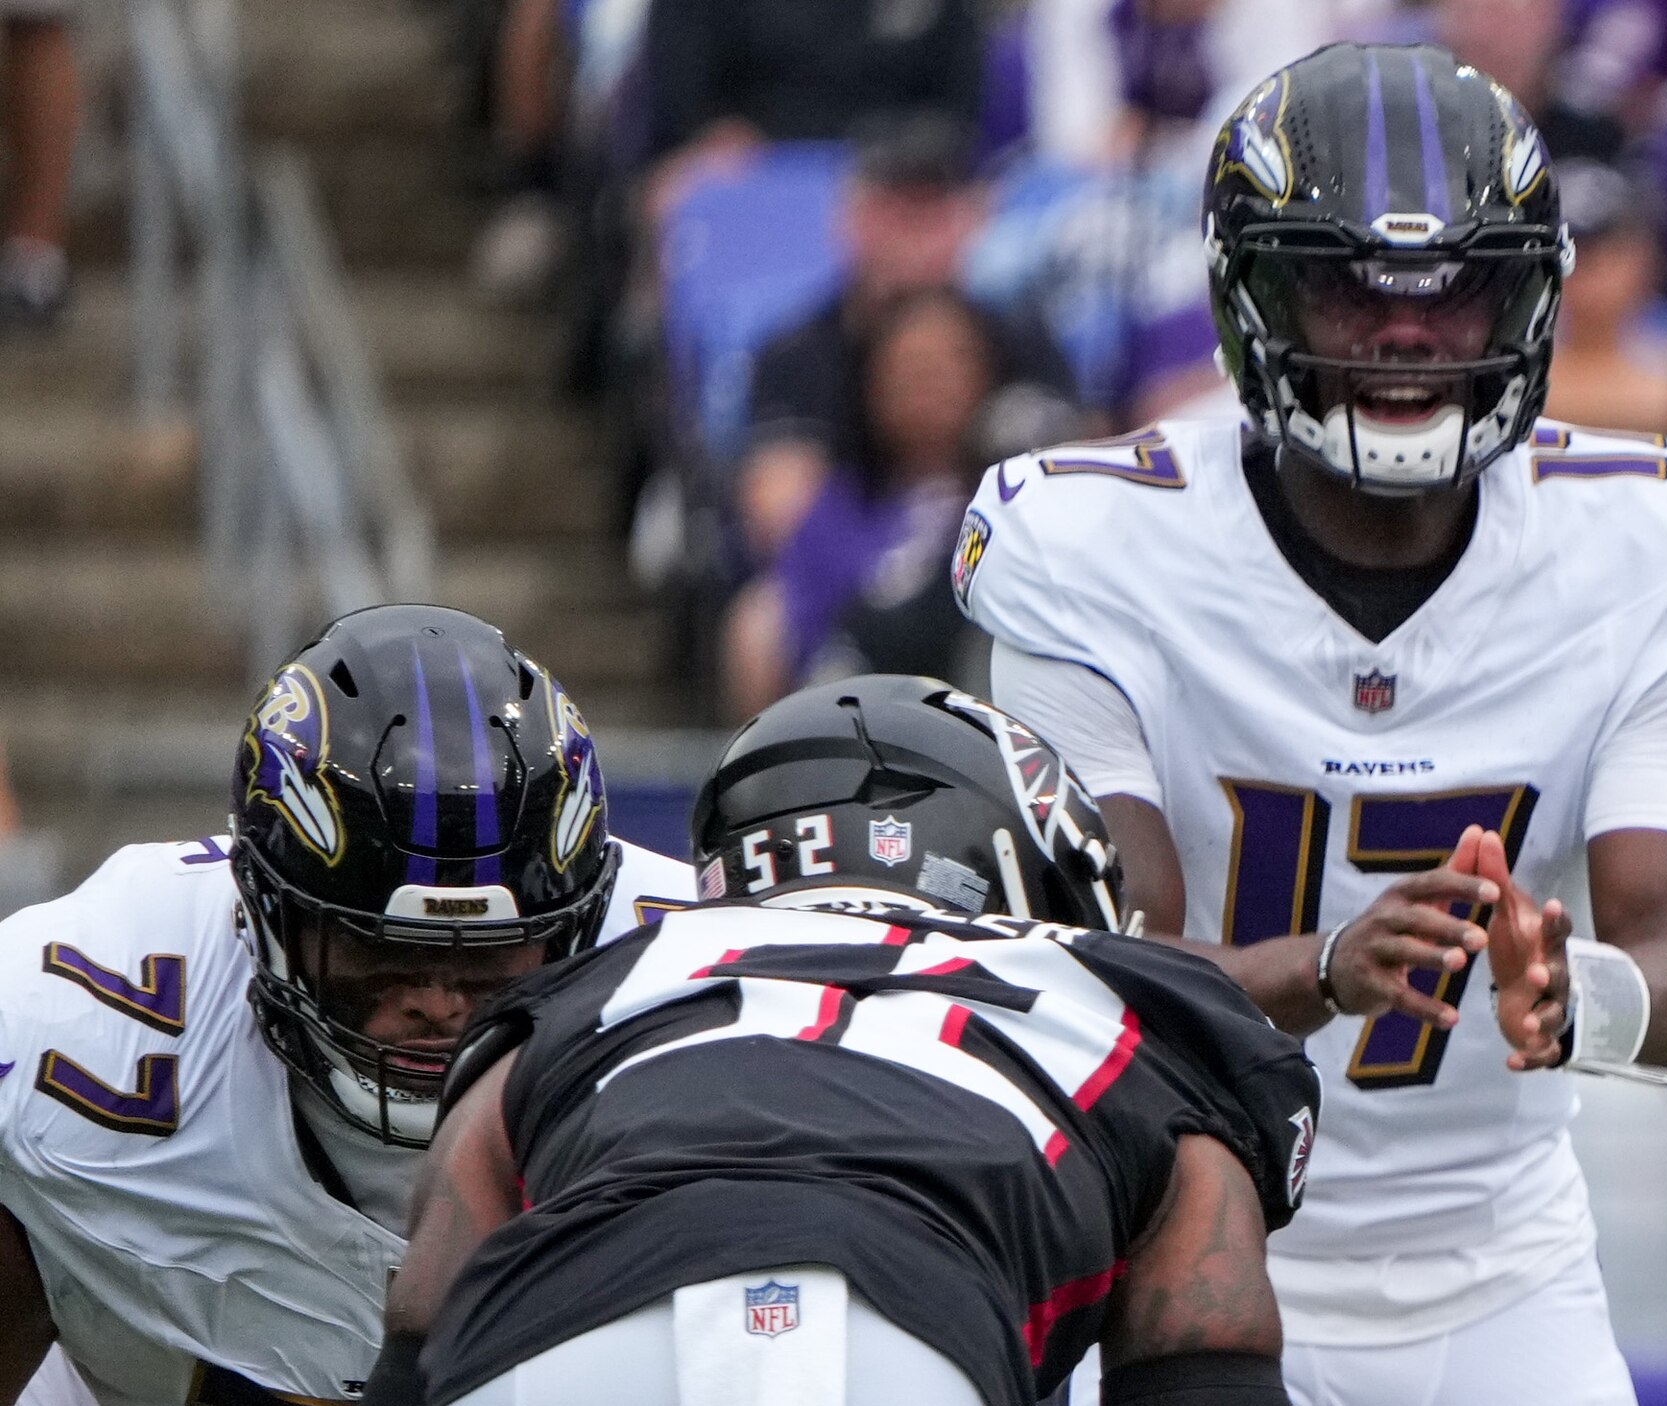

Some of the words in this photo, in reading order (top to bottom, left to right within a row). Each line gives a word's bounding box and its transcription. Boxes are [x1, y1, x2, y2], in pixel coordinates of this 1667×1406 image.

[1321, 760, 1435, 776] RAVENS
[742, 814, 836, 894] 52
[876, 838, 905, 858] NFL
[1218, 776, 1541, 1092] 17
[35, 941, 187, 1137] 77
[751, 1305, 796, 1333] NFL
